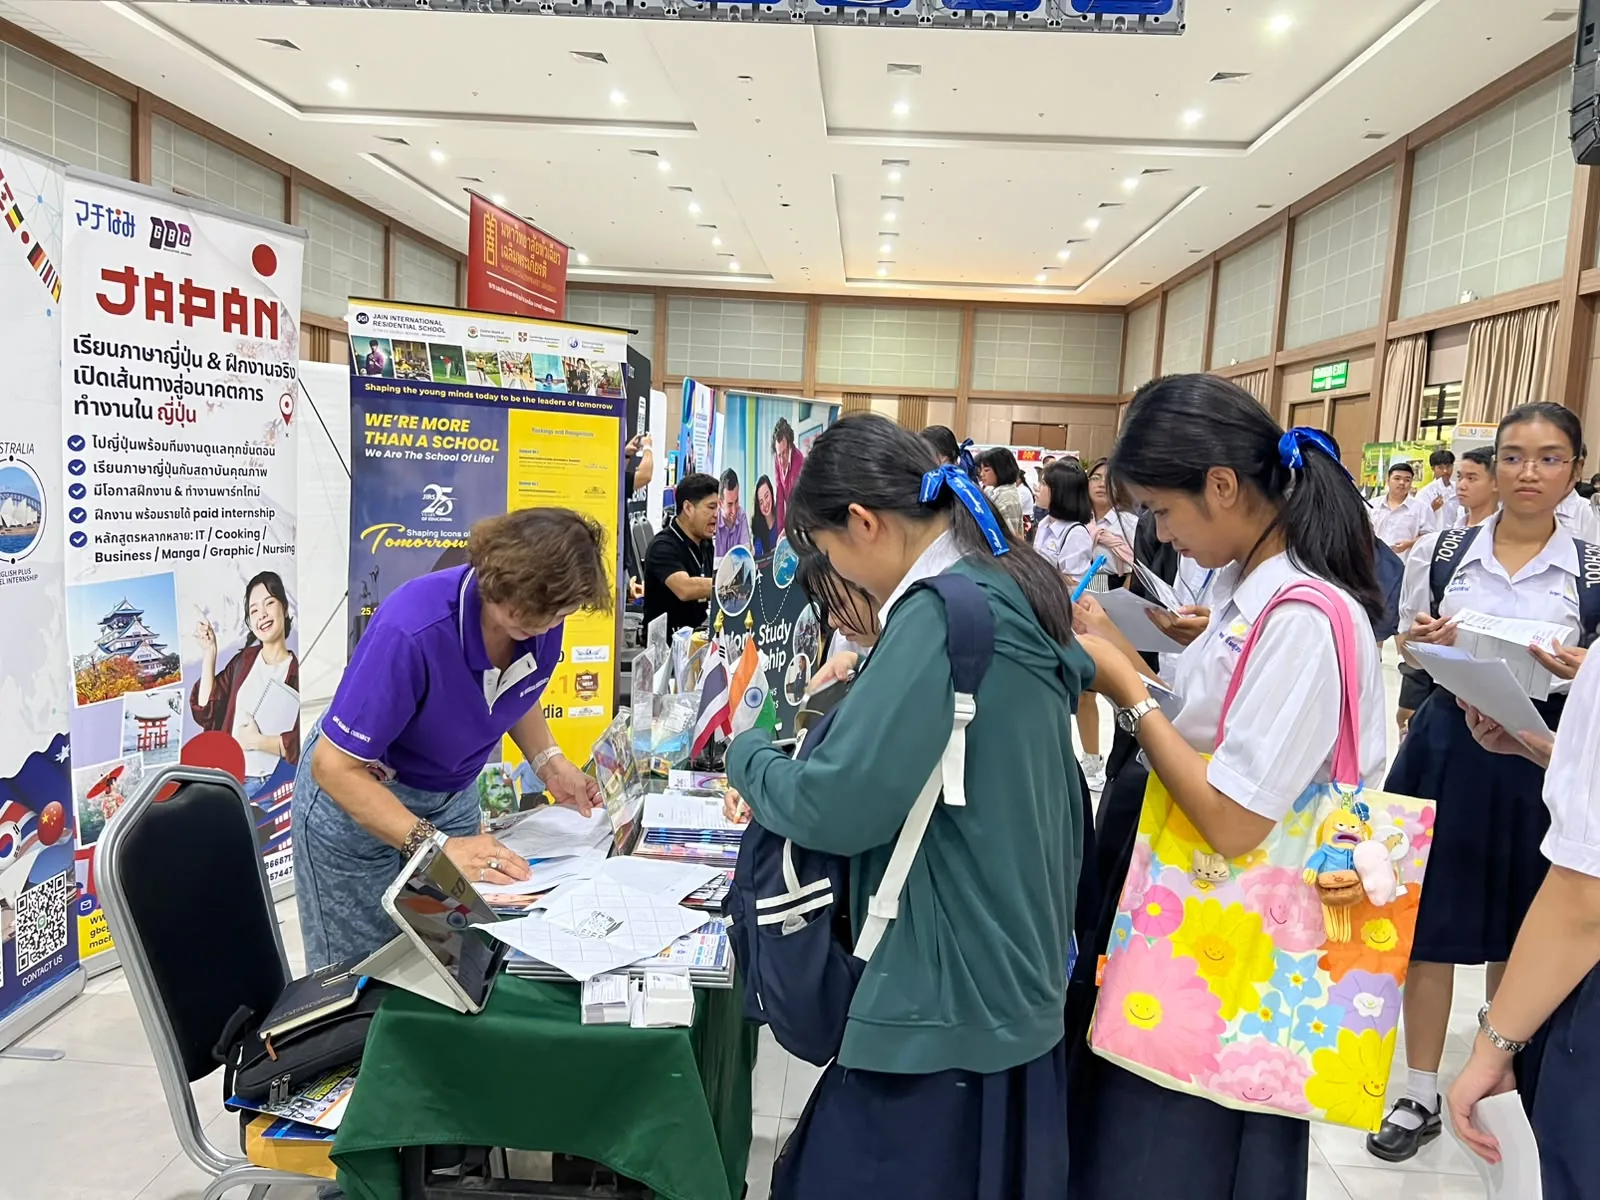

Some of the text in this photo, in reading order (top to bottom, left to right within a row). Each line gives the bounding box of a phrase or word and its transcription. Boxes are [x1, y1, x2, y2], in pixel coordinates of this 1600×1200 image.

[75, 200, 136, 239] マチなみ
[152, 221, 191, 247] GBC
[96, 266, 279, 340] JAPAN
[372, 320, 416, 331] RESIDENTIAL
[419, 325, 446, 333] SCHOOL
[390, 315, 443, 326] INTERNATIONAL
[73, 333, 296, 381] เรียนภาษาญี่ปุ่น & ฝึกงานจริง
[73, 365, 264, 402] เปิดเส้นทางสู่อนาคตการ
[364, 383, 613, 410] Shaping the young minds today to be the leaders of tomorrow
[74, 394, 197, 429] ทำงานใน ญี่ปุ่น
[421, 416, 470, 433] MORE
[364, 431, 414, 447] THAN
[415, 434, 429, 448] A
[431, 435, 500, 452] SCHOOL
[364, 449, 494, 464] We Are The School Of Life!
[93, 458, 268, 479] เรียนภาษาญี่ปุ่นกับสถาบันคุณภาพ
[94, 484, 171, 498] มีโอกาสฝึกงาน
[175, 486, 183, 497] &
[421, 483, 454, 516] 25
[94, 507, 276, 522] ฝึกงาน พร้อมรายได้ paid internship
[195, 530, 205, 540] IT
[208, 527, 213, 542] /
[215, 529, 260, 543] Cooking
[262, 525, 267, 540] /
[407, 529, 439, 539] Shaping
[95, 542, 295, 563] Business / Manga / Graphic / Nursing
[7, 573, 38, 584] INTERNSHIP
[757, 618, 793, 645] Study
[22, 954, 64, 987] CONTACT US
